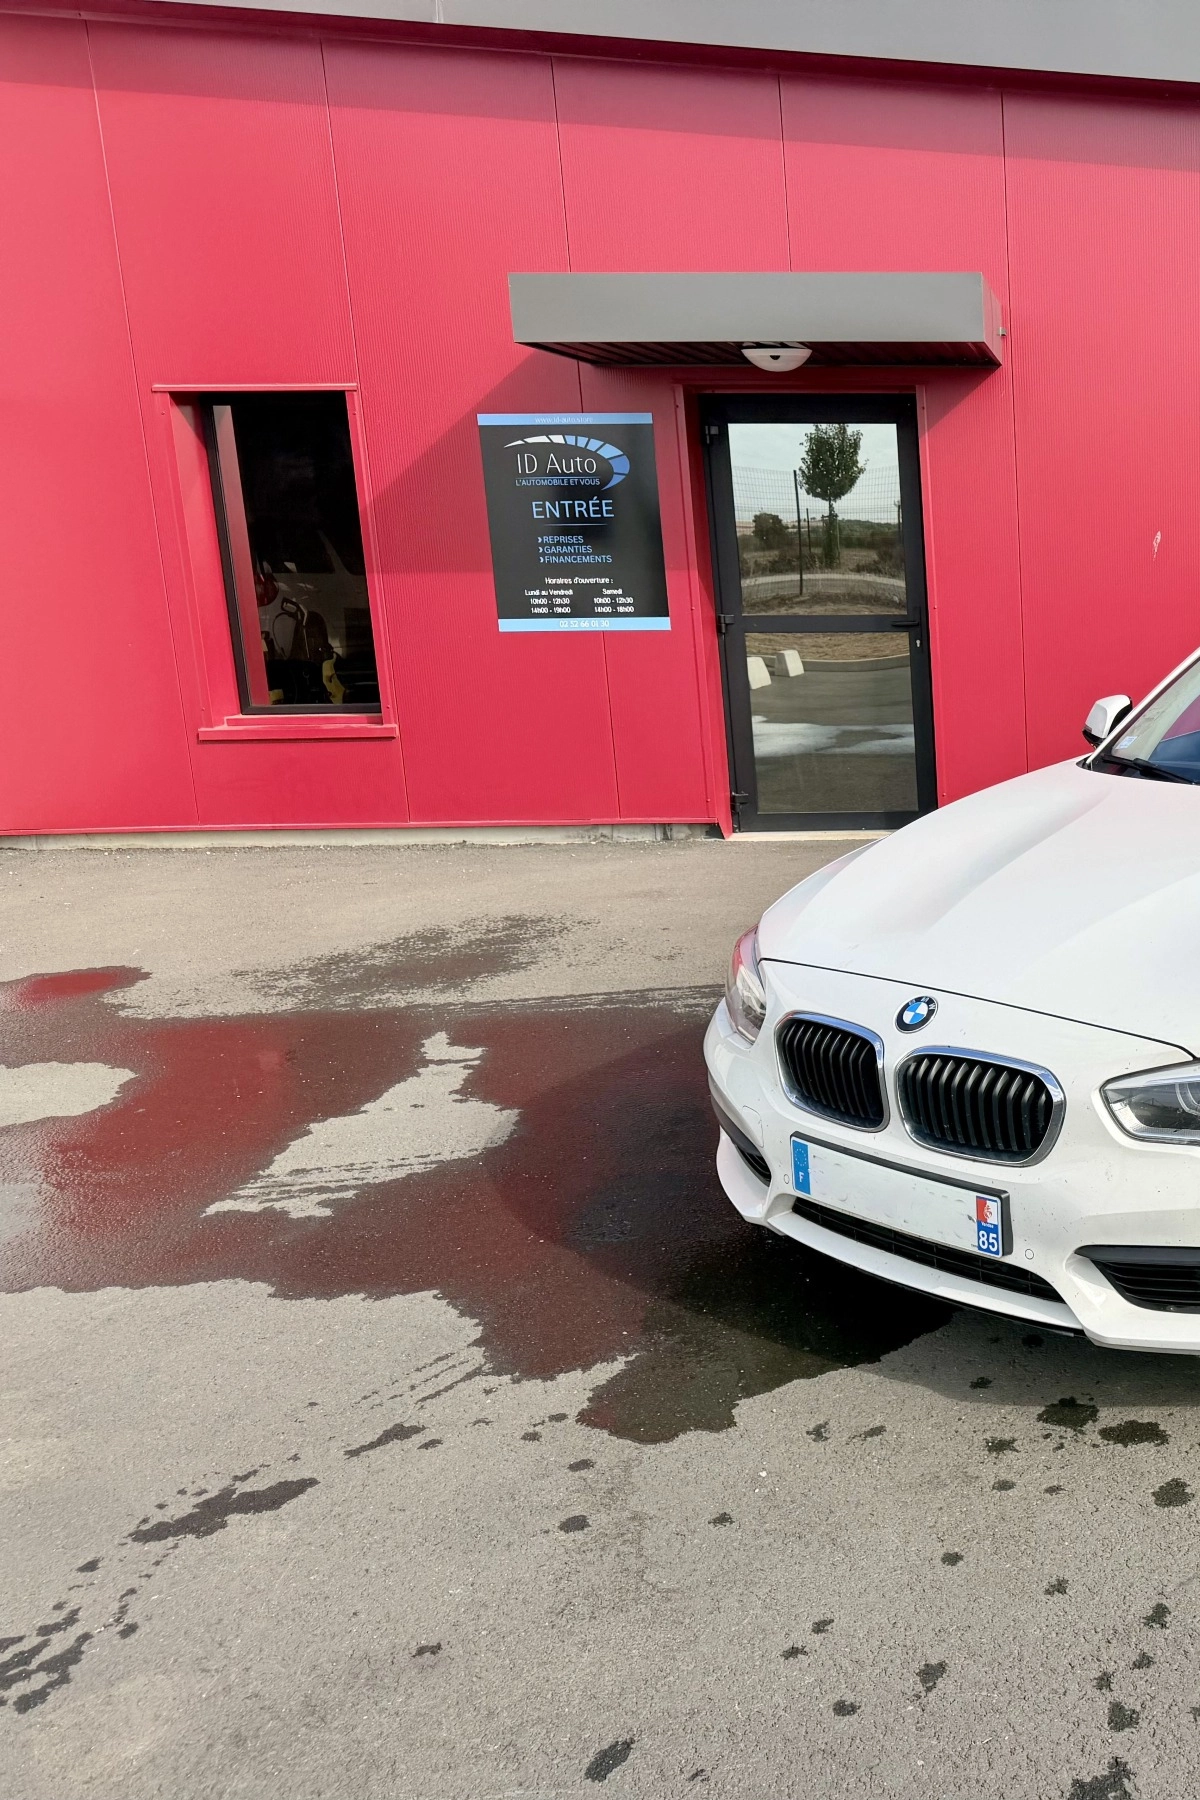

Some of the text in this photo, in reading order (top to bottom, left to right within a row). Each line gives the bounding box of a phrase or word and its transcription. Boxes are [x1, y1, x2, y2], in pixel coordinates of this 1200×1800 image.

[517, 453, 597, 474] ID Auto
[515, 478, 600, 487] L'AUTOMOBILE ET VOUS
[532, 496, 615, 519] ENTRÉE
[543, 535, 584, 544] REPRISES
[544, 545, 593, 554] GARANTIES
[545, 555, 613, 563] FINANCEMENTS
[798, 1171, 805, 1183] F
[978, 1230, 998, 1252] 85
